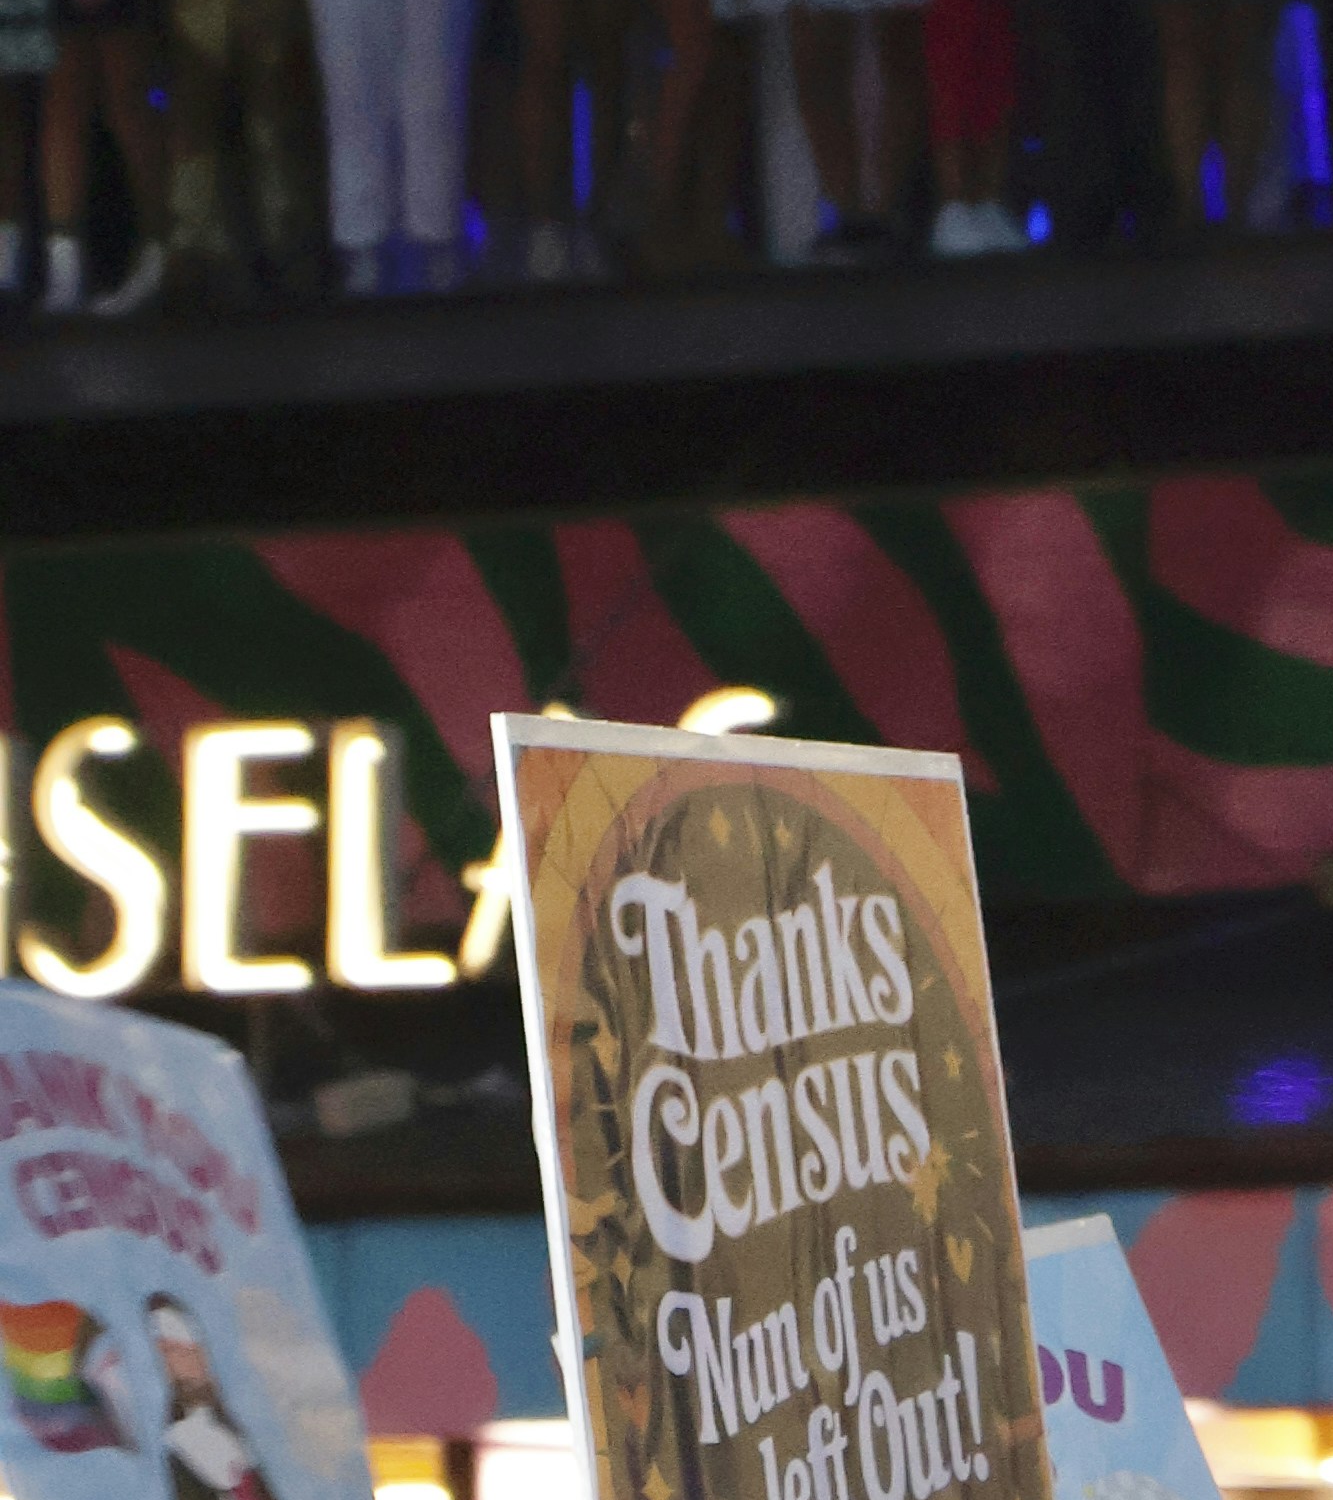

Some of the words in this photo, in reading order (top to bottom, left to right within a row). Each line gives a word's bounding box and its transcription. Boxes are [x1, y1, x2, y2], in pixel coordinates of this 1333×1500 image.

[610, 860, 914, 1062] Thanks
[631, 1050, 932, 1265] Census
[657, 1290, 810, 1445] Nun
[813, 1225, 860, 1407] of
[863, 1249, 927, 1346] us
